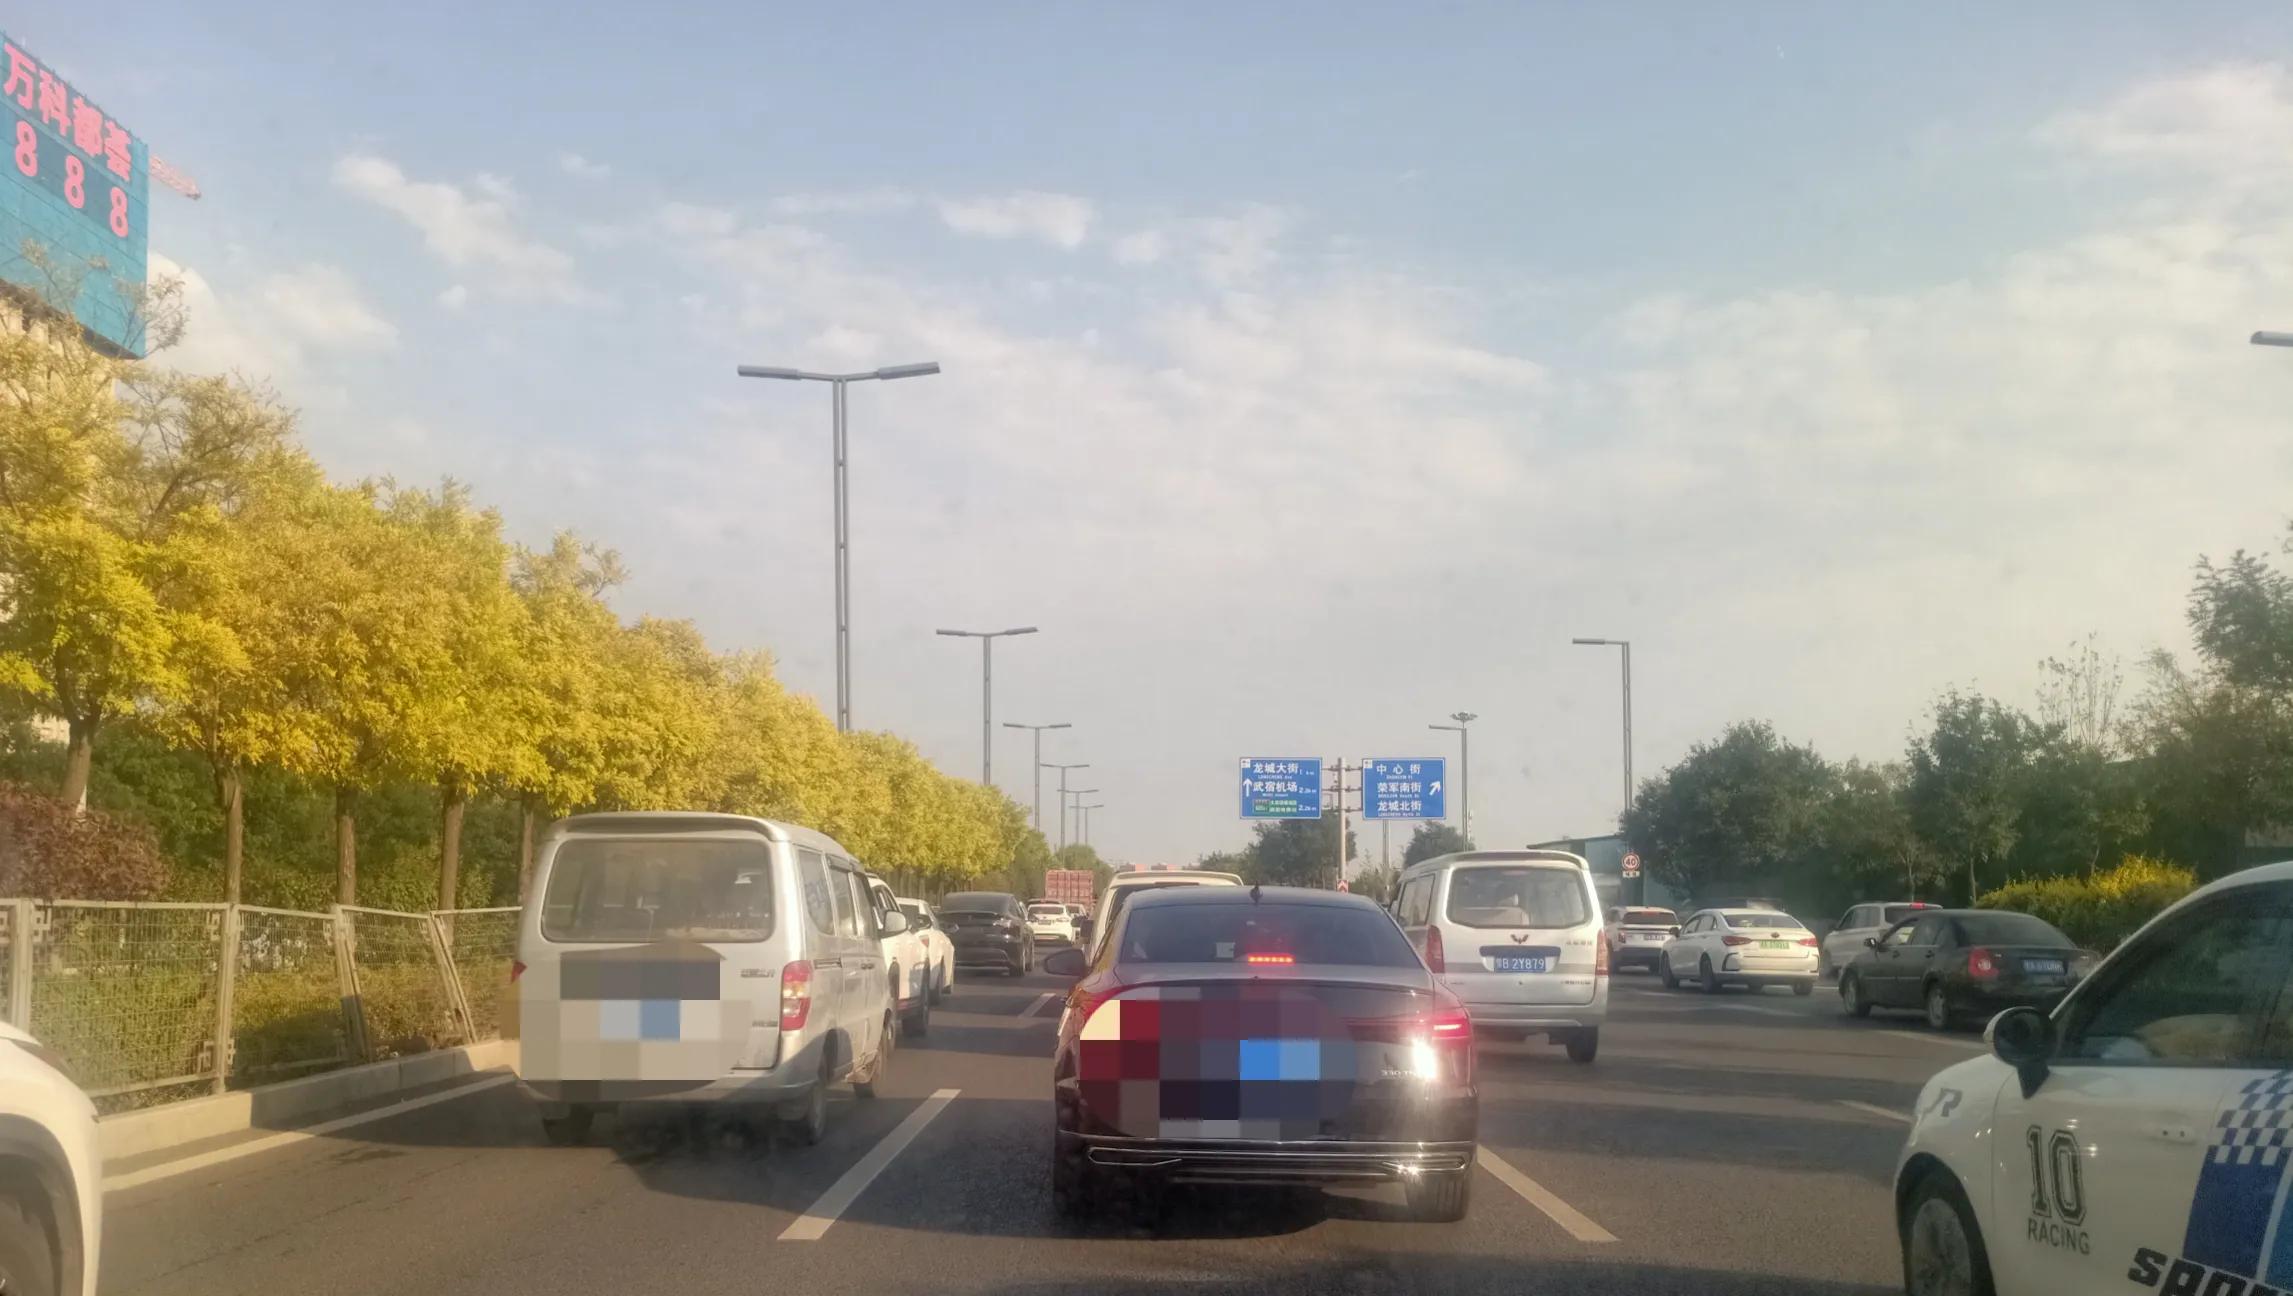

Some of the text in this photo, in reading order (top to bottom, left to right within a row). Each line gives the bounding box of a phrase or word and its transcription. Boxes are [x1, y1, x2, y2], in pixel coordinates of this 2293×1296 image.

[1253, 763, 1298, 774] 龙城大街
[1376, 763, 1420, 775] 中心街
[1253, 781, 1297, 792] 武宿机场
[1377, 800, 1421, 811] 龙城北街
[1622, 858, 1637, 866] 40
[2027, 1125, 2087, 1225] 10
[2027, 1218, 2091, 1255] RACING
